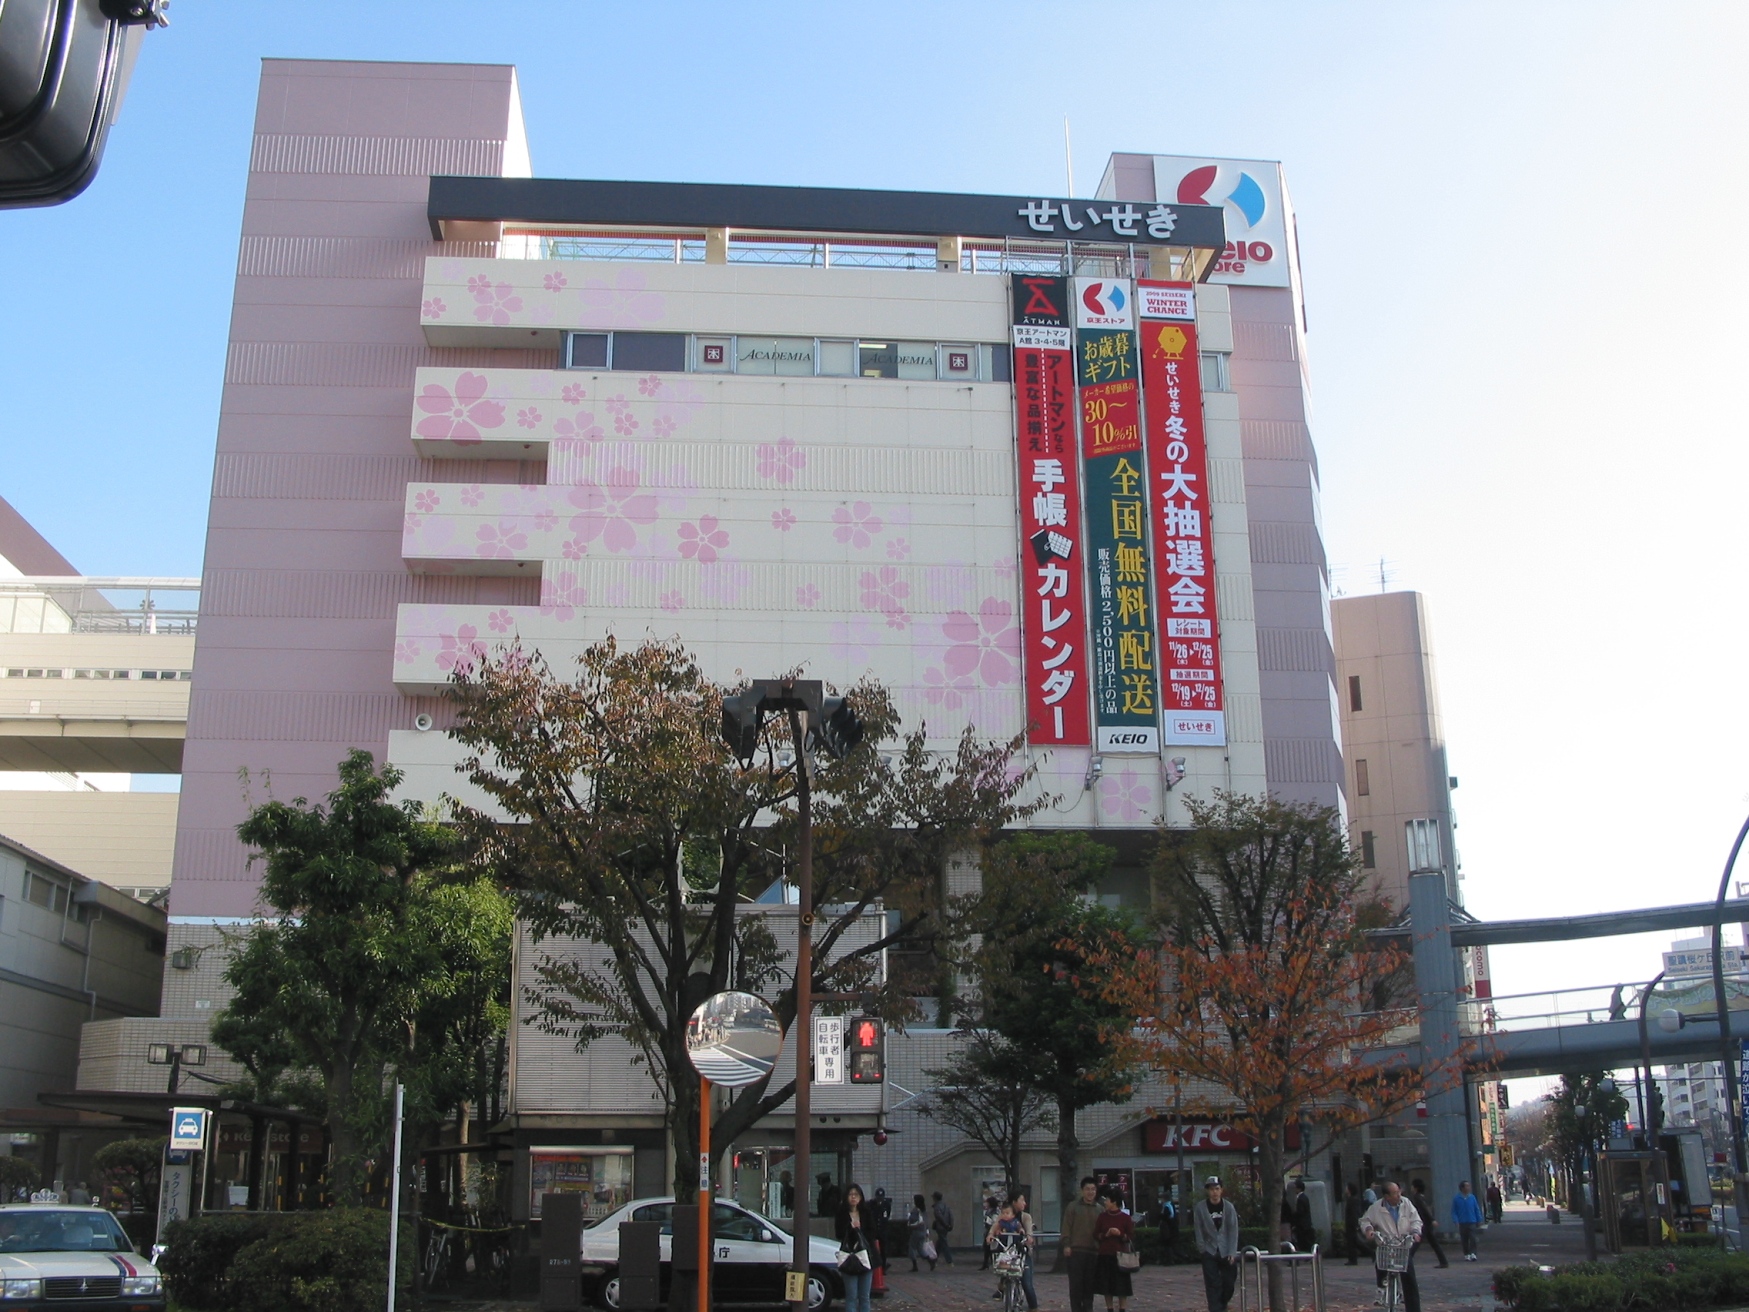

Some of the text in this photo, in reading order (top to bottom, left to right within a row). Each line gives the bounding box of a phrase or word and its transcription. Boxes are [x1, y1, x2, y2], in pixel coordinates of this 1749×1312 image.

[1018, 200, 1178, 239] せいせき
[1146, 299, 1188, 307] WINTER
[1147, 306, 1188, 315] CHANCE
[1017, 328, 1067, 337] 京王アートマン
[1085, 332, 1129, 361] お歳暮
[1085, 357, 1131, 383] ギフト
[1025, 353, 1042, 452] 豊富な品揃え
[1047, 354, 1067, 453] アートマンなら
[1161, 362, 1206, 614] せいせき冬の大抽選会
[1109, 457, 1154, 715] 全国無料配送
[1032, 458, 1075, 739] 手帳 カレンダー
[1175, 627, 1205, 636] 対象期間
[1176, 619, 1204, 627] レシート
[1176, 671, 1209, 679] 抽選期間
[1178, 722, 1212, 732] せいせき
[1109, 734, 1148, 745] KEIO
[819, 1022, 829, 1055] 自転車
[830, 1022, 840, 1055] 歩行者
[824, 1057, 835, 1079] 専用
[1162, 1124, 1231, 1147] KFC
[719, 1246, 730, 1258] 庁
